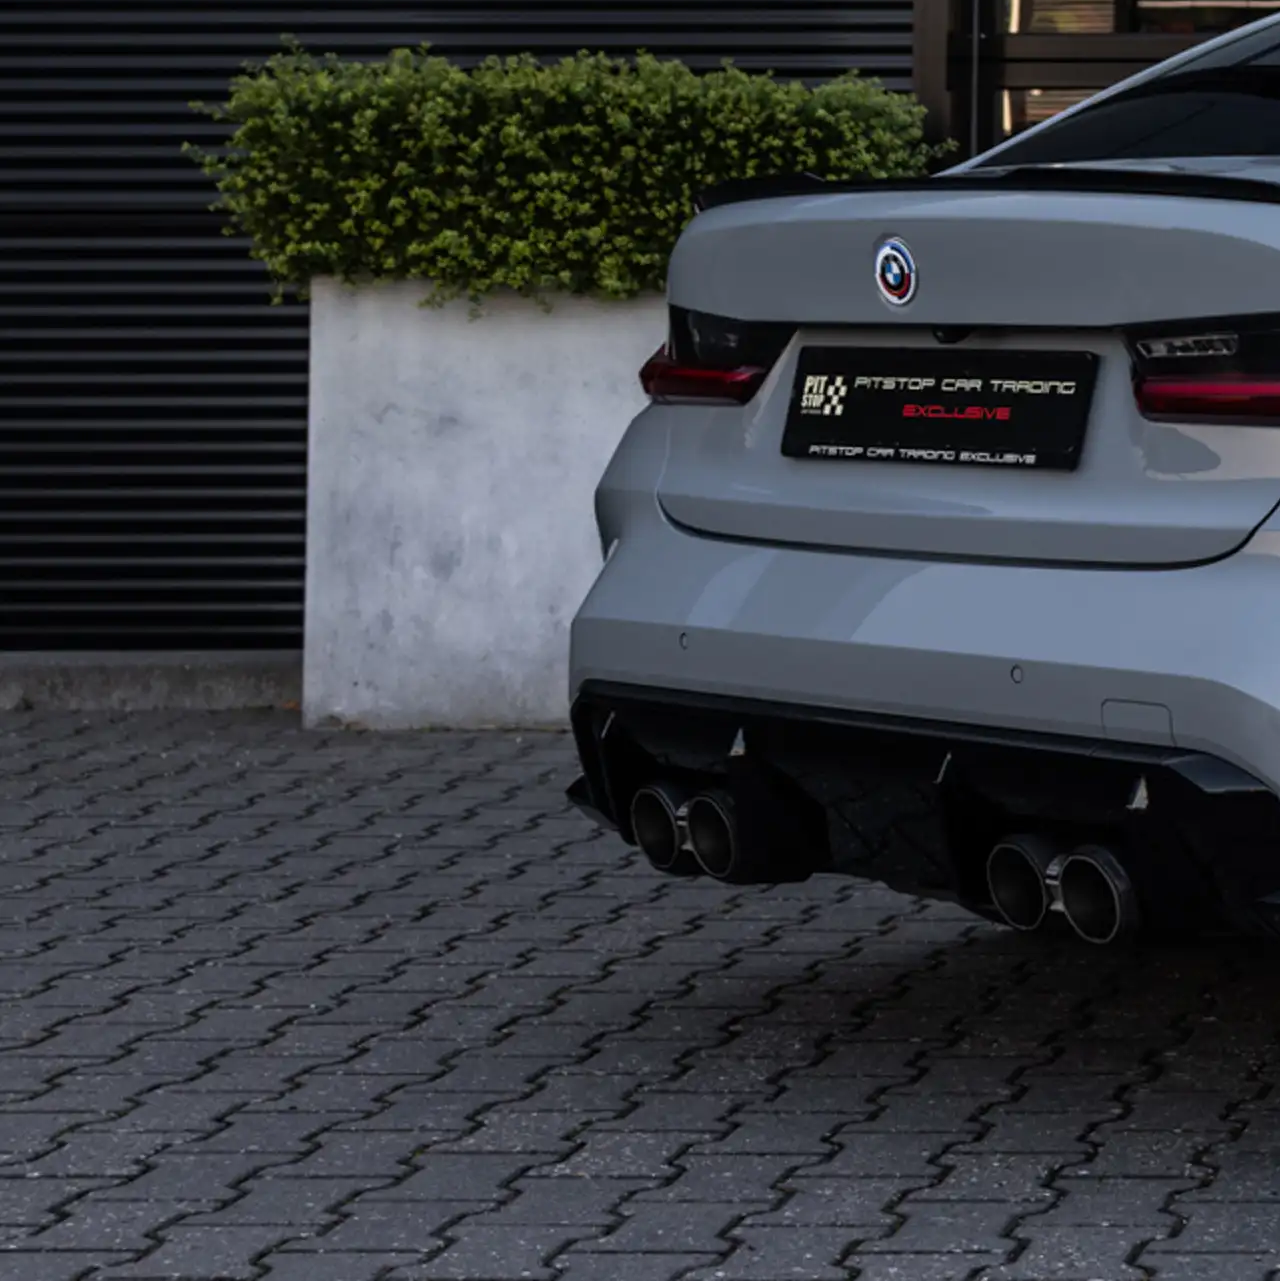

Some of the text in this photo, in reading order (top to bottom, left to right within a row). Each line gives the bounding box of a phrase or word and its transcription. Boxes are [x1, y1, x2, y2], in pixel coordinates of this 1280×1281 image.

[804, 375, 829, 394] PIT
[854, 375, 1077, 395] PITSTOP CAR TRADING
[801, 394, 825, 408] STOP
[902, 403, 1012, 420] EXCLUSIVE
[808, 444, 864, 456] PITSTOP
[959, 450, 1037, 465] EXCLUSIVE
